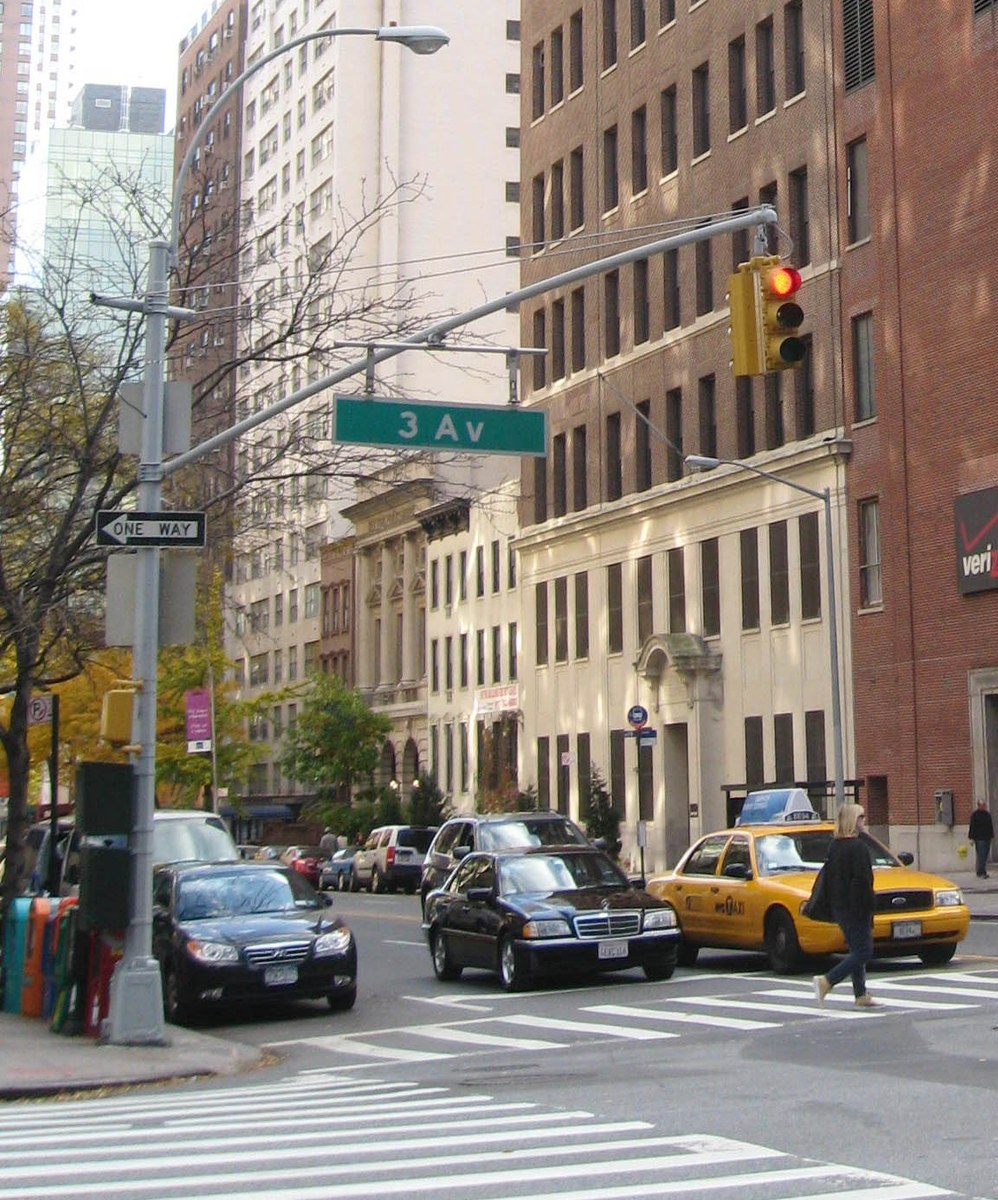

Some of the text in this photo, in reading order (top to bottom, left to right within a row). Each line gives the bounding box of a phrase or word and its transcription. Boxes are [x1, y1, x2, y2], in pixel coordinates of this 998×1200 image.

[397, 411, 485, 442] 3 Av
[113, 522, 191, 536] ONE WAY
